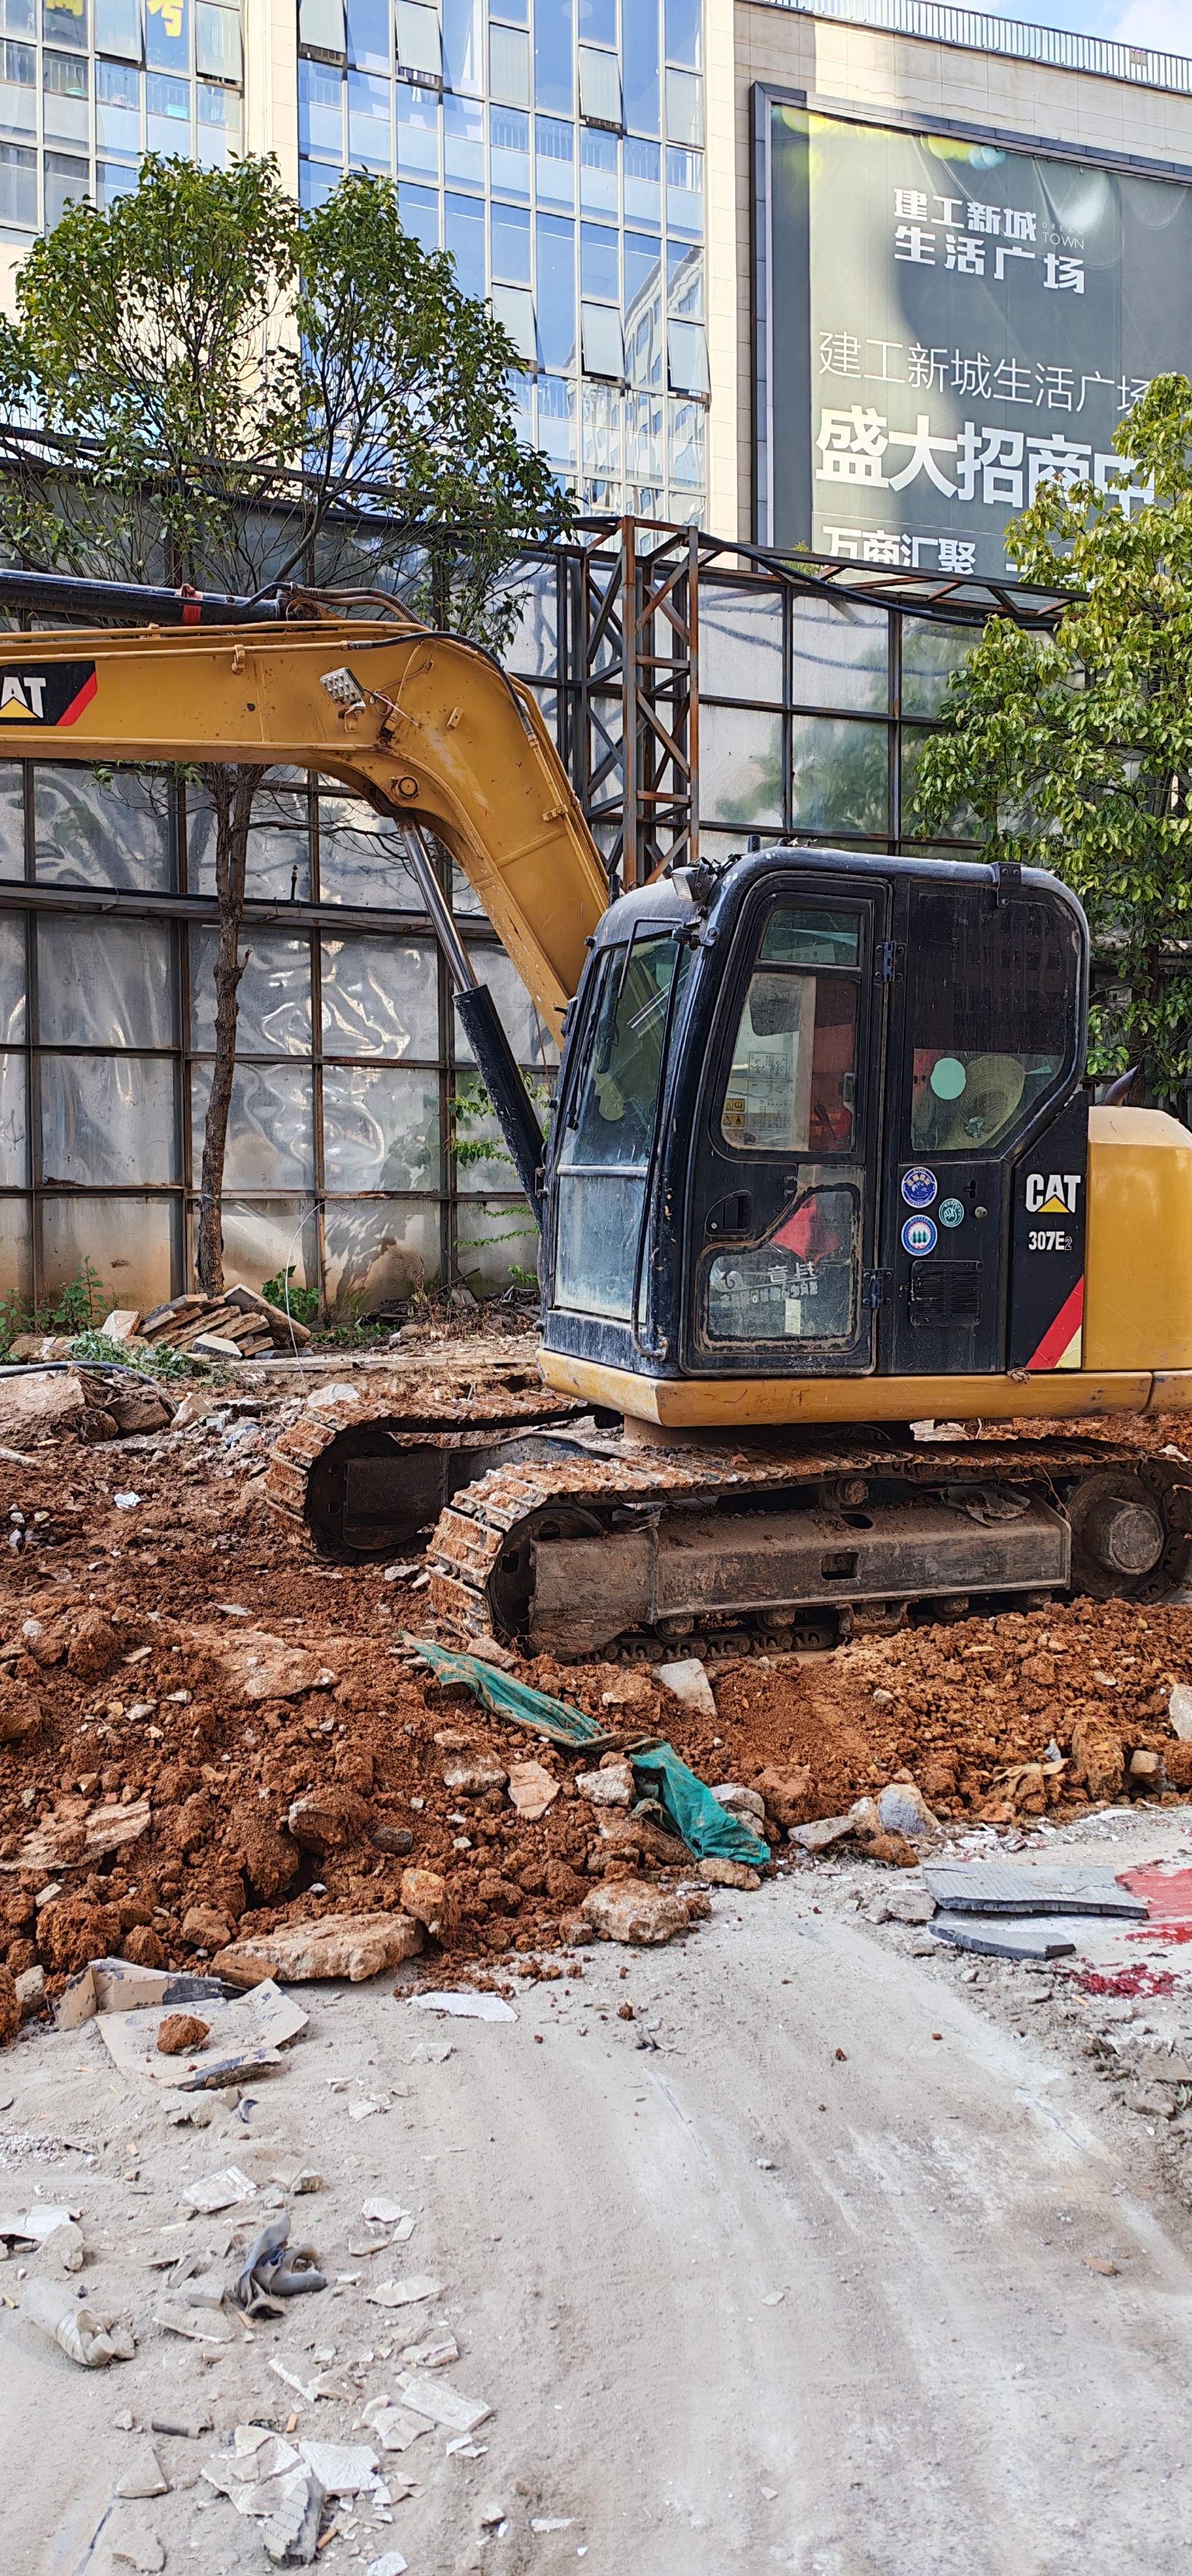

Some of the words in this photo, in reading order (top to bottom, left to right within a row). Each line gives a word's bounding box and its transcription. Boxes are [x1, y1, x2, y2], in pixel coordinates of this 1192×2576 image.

[894, 188, 1036, 242] 建工新城
[895, 225, 1084, 294] 生活广场
[1042, 231, 1084, 250] TOWN
[819, 330, 1149, 415] 建工新城生活广场
[823, 526, 976, 574] 万商汇聚
[0, 677, 46, 718] AT
[1025, 1174, 1081, 1213] CAT
